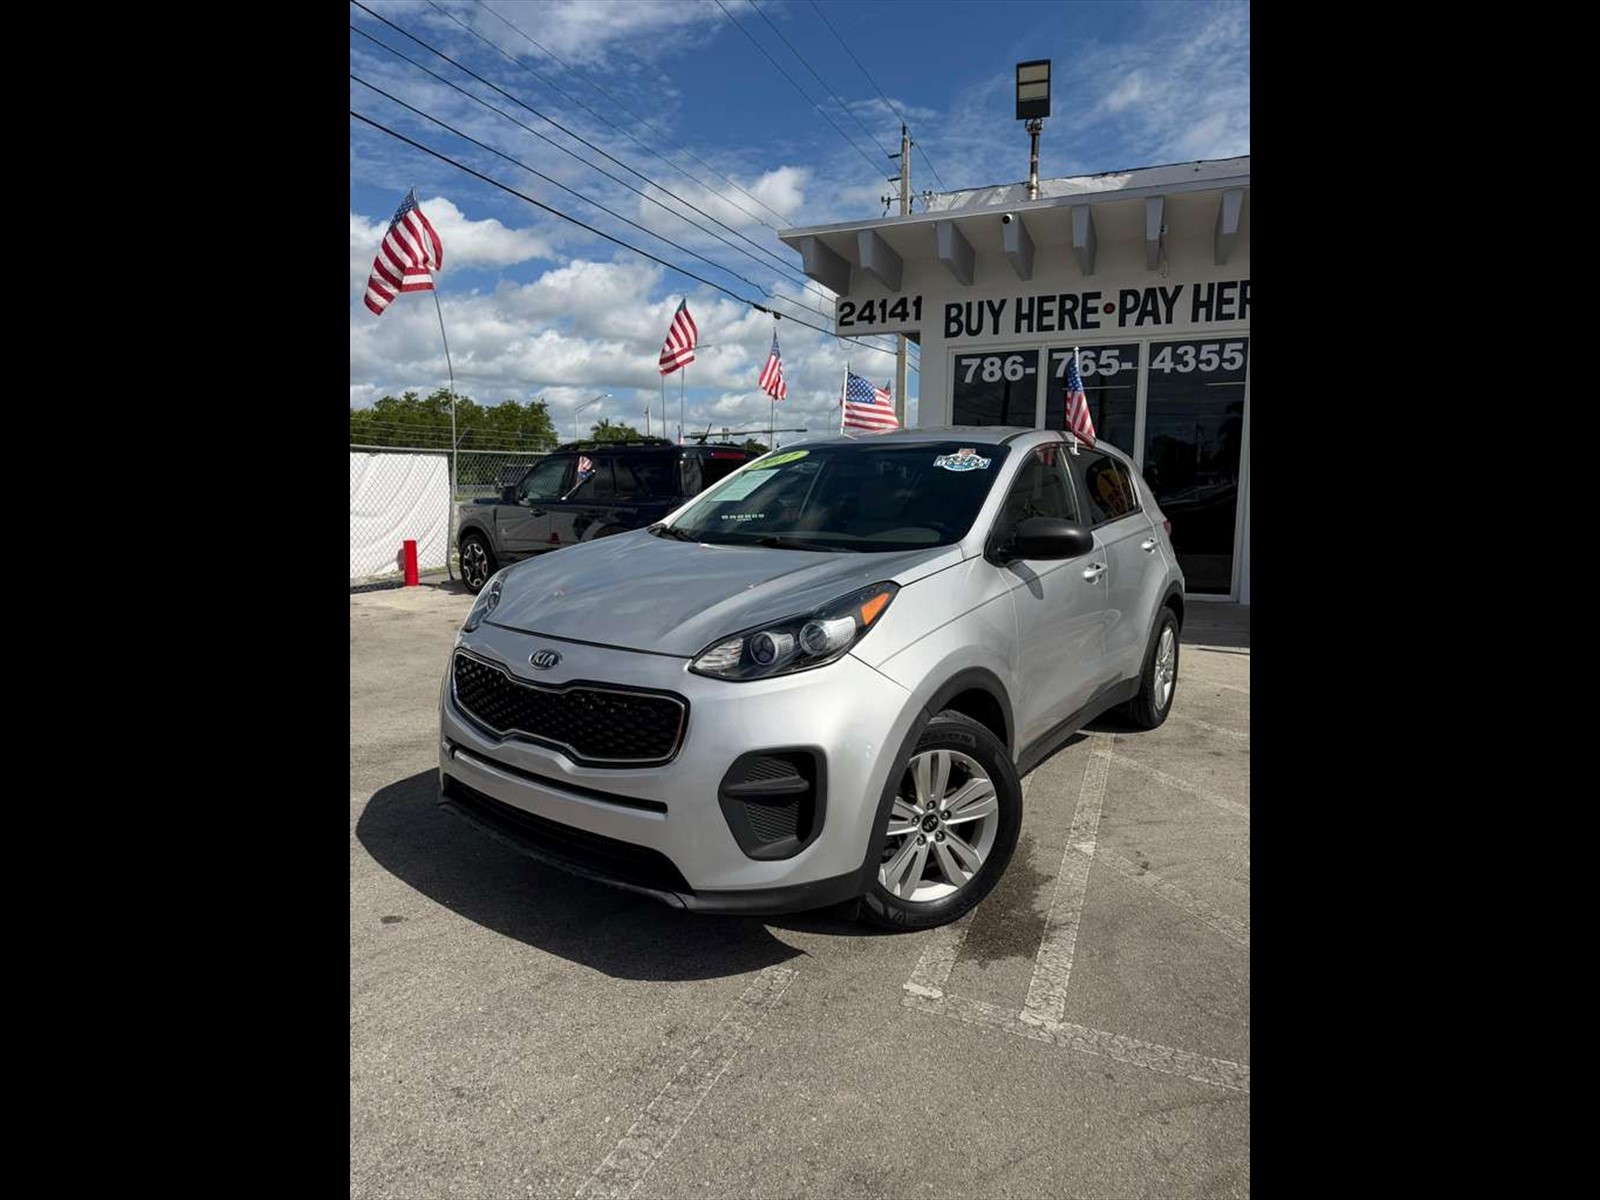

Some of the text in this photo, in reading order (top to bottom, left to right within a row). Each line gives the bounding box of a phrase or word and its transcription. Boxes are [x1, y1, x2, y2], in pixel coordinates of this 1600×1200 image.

[839, 295, 923, 327] 24141
[945, 299, 1007, 338] BUY
[1014, 291, 1102, 333] HERE
[1118, 285, 1184, 327] PAY
[961, 343, 1244, 383] 786- 765- 4355
[531, 652, 555, 666] KIA
